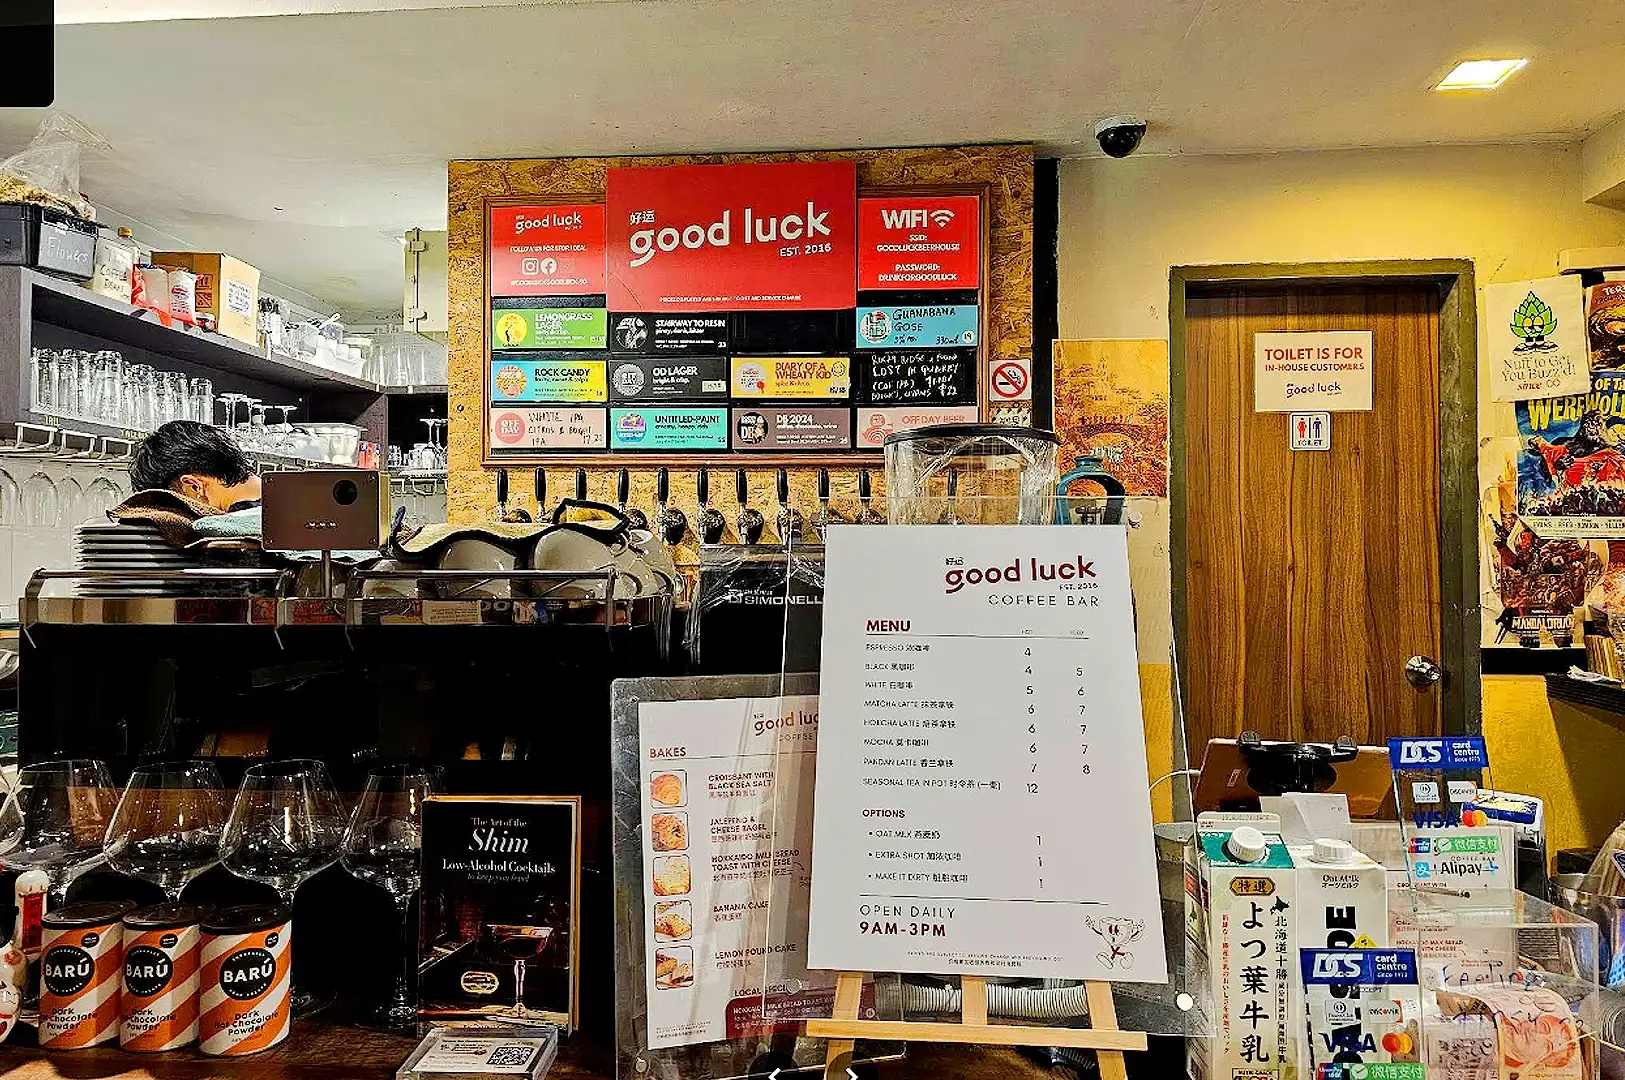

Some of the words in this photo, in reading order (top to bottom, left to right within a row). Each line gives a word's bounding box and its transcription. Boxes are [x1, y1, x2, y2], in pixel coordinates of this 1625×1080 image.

[515, 214, 549, 234] good
[553, 212, 582, 226] luck
[881, 209, 928, 229] WIFI
[629, 209, 730, 268] good
[744, 201, 831, 244] luck
[48, 237, 89, 263] Flowers
[779, 247, 801, 257] EST.
[805, 243, 832, 254] 2016
[535, 312, 593, 322] LEMONGRASS
[892, 308, 956, 320] GUANABANA
[535, 321, 563, 330] LAGER
[655, 319, 693, 328] STAIRWAY
[694, 319, 704, 328] TO
[704, 319, 726, 328] RESIN
[892, 322, 923, 332] GOSE
[1264, 348, 1313, 361] TOILET
[1317, 348, 1330, 360] IS
[1334, 347, 1363, 359] FOR
[652, 367, 667, 377] OD
[668, 366, 699, 377] LAGER
[775, 362, 802, 371] DIARY
[805, 362, 817, 371] OF
[818, 362, 826, 370] A
[1265, 363, 1308, 372] IN-HOUSE
[1310, 363, 1365, 372] CUSTOMERS
[534, 368, 558, 377] ROCK
[560, 368, 591, 377] CANDY
[775, 371, 814, 379] WHEATY
[815, 370, 832, 379] KID
[1595, 378, 1612, 390] OF
[1286, 384, 1315, 399] good
[1317, 381, 1341, 393] luck
[789, 415, 813, 424] 2024
[902, 416, 921, 425] OFF
[923, 415, 942, 424] DAY
[945, 558, 1021, 594] good
[1031, 555, 1097, 581] luck
[744, 595, 825, 605] SIMONELL
[988, 595, 1057, 606] COFFEE
[1066, 595, 1099, 607] BAR
[866, 620, 911, 632] MENU
[866, 644, 904, 652] ESPRESSO
[1024, 648, 1032, 657] 4
[1025, 666, 1032, 675] 4
[1076, 667, 1083, 677] 5
[1026, 686, 1034, 695] 5
[1078, 687, 1085, 696] 6
[864, 700, 897, 708] MATCHA
[1028, 705, 1035, 714] 6
[1079, 706, 1086, 715] 7
[754, 714, 794, 736] good
[1028, 724, 1036, 734] 6
[1080, 725, 1087, 735] 7
[1029, 743, 1037, 753] 6
[1081, 744, 1088, 755] 7
[1452, 740, 1472, 749] card
[650, 747, 686, 759] BAKES
[1400, 741, 1443, 764] DCS
[1453, 749, 1480, 757] centre
[863, 758, 895, 766] PANDAN
[1031, 763, 1038, 773] 7
[1083, 764, 1091, 775] 8
[708, 773, 752, 782] CROISSANT
[754, 771, 774, 780] WITH
[708, 782, 735, 790] BLACK
[753, 780, 772, 788] SALT
[863, 779, 904, 787] SEASONAL
[906, 779, 921, 787] TEA
[931, 780, 948, 788] POT
[1026, 783, 1039, 794] 12
[862, 809, 906, 819] OPTIONS
[471, 817, 488, 827] The
[503, 818, 513, 827] of
[1412, 811, 1459, 829] VISA
[710, 826, 740, 835] CHEESE
[876, 831, 894, 839] OAT
[468, 827, 530, 854] Shim
[1037, 836, 1042, 846] 1
[711, 854, 753, 863] HOKKAIDO
[902, 852, 925, 860] SHOT
[442, 858, 507, 873] Low-Alcohol
[508, 861, 556, 875] Cocktails
[711, 863, 738, 872] TOAST
[739, 861, 761, 870] WITH
[1440, 861, 1483, 876] Alipay
[875, 873, 897, 881] MAKE
[899, 873, 906, 881] IT
[1322, 874, 1342, 883] Oat
[713, 903, 746, 913] BANANA
[748, 901, 770, 910] CAKE
[860, 905, 903, 917] OPEN
[910, 905, 956, 919] DAILY
[859, 921, 946, 937] 9AM-3PM
[715, 951, 744, 960] LEMON
[745, 947, 773, 957] POUND
[774, 944, 797, 953] CAKE
[1275, 915, 1288, 981] 北海道十勝
[1375, 953, 1398, 963] card
[45, 957, 90, 978] BARÚ
[126, 958, 168, 978] BARÚ
[223, 957, 273, 983] BARÚ
[1313, 953, 1363, 978] DCS
[1377, 962, 1408, 971] centre
[1239, 901, 1270, 1064] よつ葉牛乳
[734, 988, 761, 998] LOCAL
[234, 1010, 260, 1021] Dark
[46, 1022, 80, 1030] Powder
[127, 1023, 159, 1031] Powder
[228, 1023, 265, 1036] Powder
